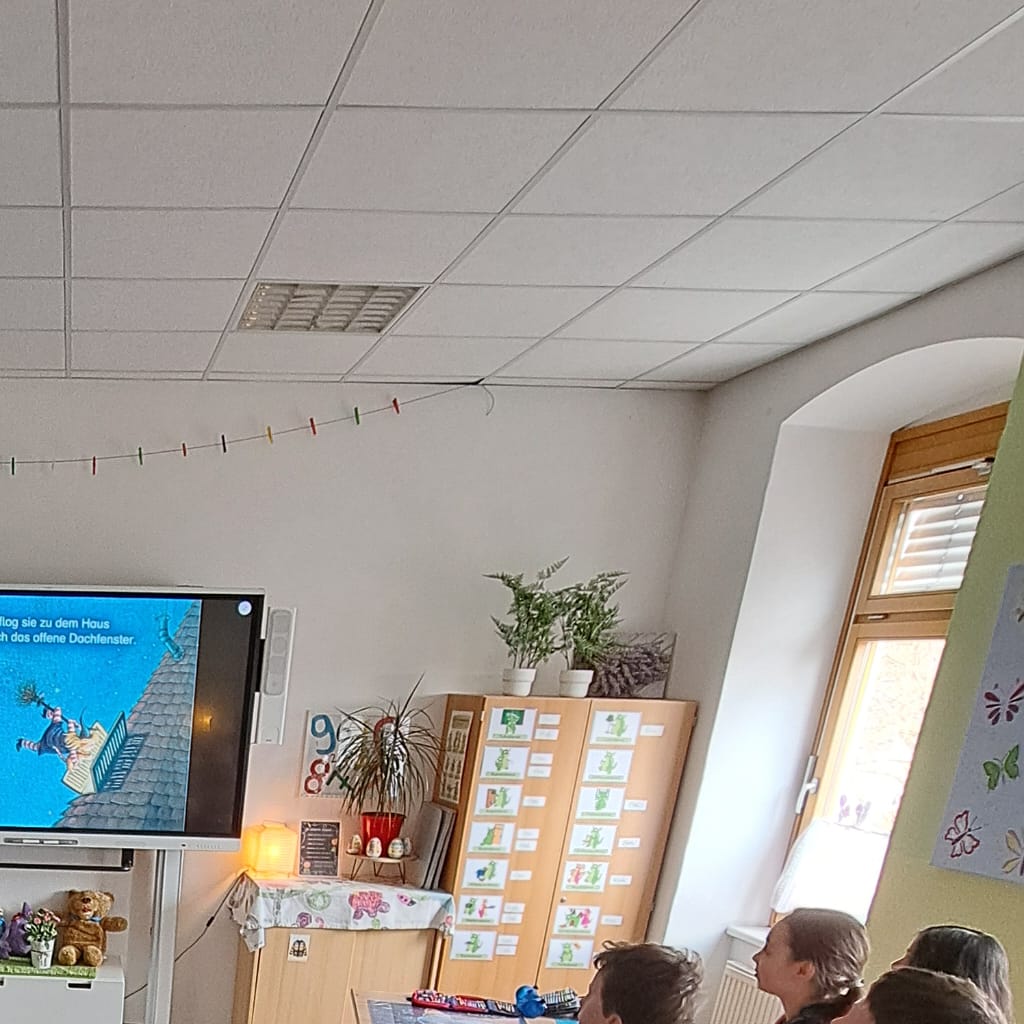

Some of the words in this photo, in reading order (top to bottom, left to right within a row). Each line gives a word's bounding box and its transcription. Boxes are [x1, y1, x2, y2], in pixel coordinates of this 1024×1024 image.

[21, 616, 37, 628] sie
[39, 619, 53, 628] zu
[55, 617, 78, 628] dem
[81, 618, 110, 629] Haus
[10, 631, 30, 643] das
[32, 632, 66, 643] offene
[68, 632, 136, 645] Dachfenster.
[311, 714, 336, 755] 9
[304, 759, 330, 794] 8
